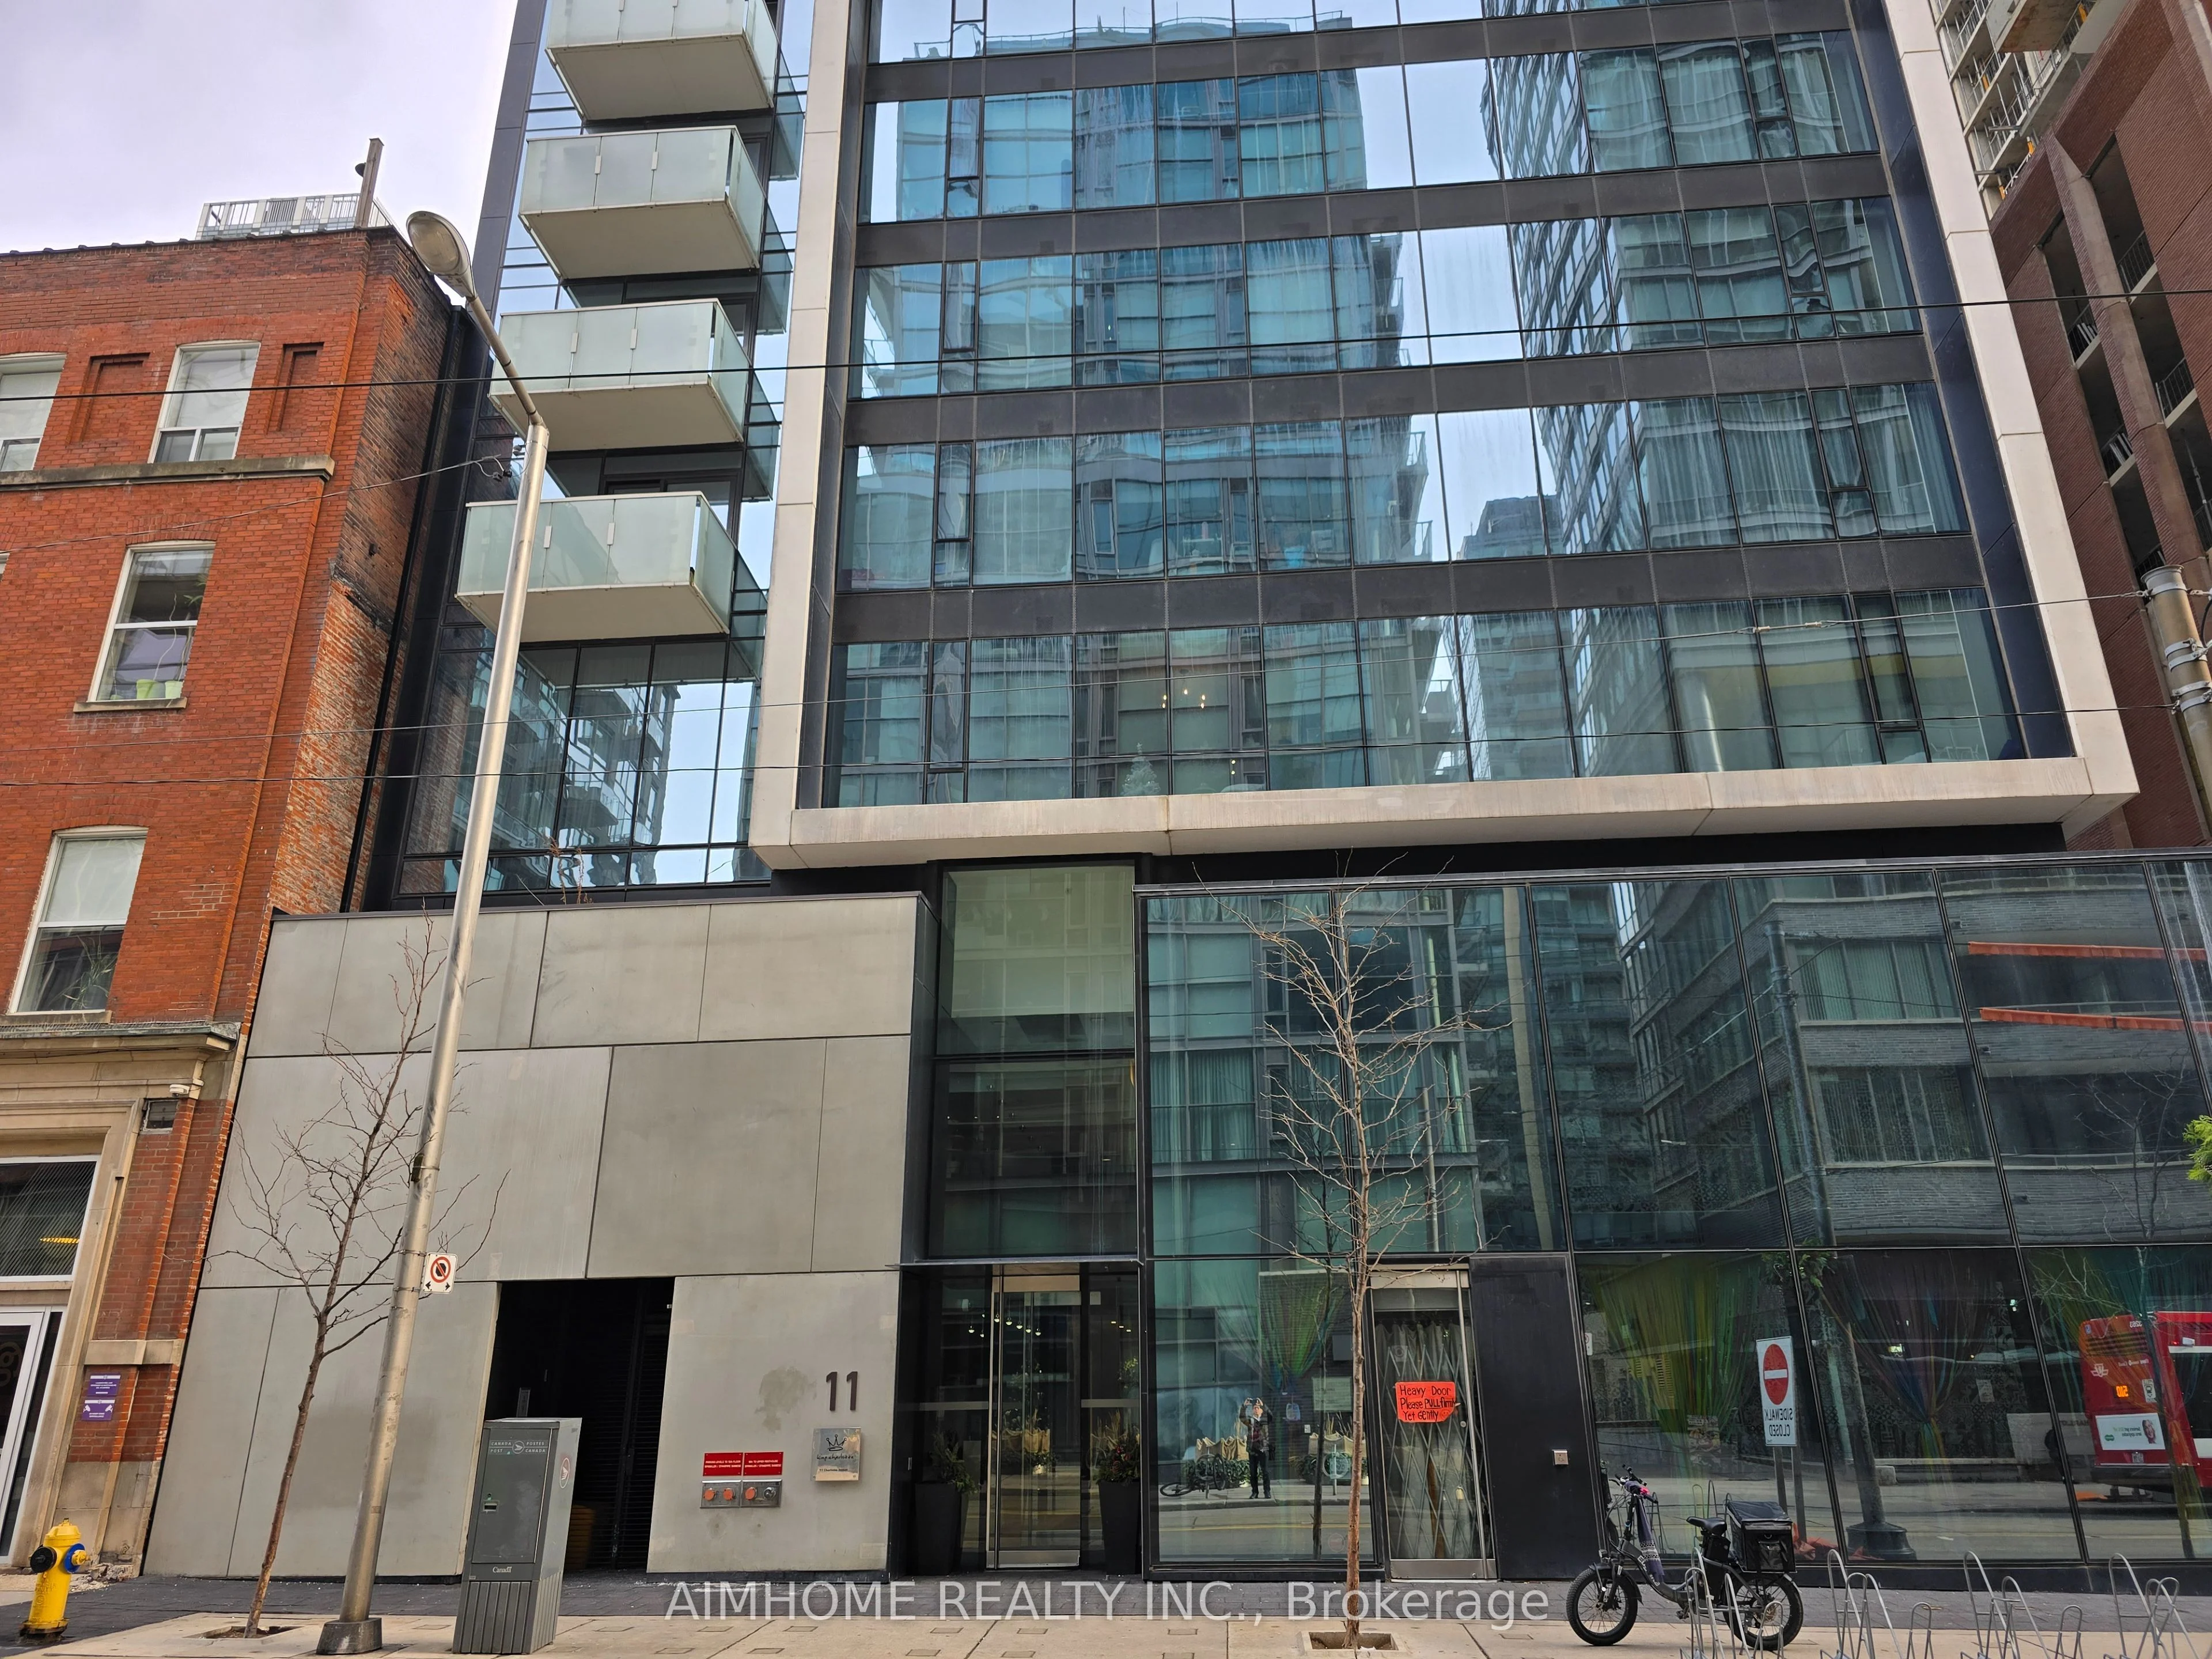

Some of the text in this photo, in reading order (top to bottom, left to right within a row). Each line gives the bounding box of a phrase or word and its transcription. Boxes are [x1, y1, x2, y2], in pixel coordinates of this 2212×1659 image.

[826, 1372, 858, 1411] 11
[1400, 1385, 1451, 1398] Heavy Door
[1400, 1397, 1423, 1410] Please
[1424, 1398, 1440, 1408] PULL
[1403, 1410, 1415, 1421] Yet
